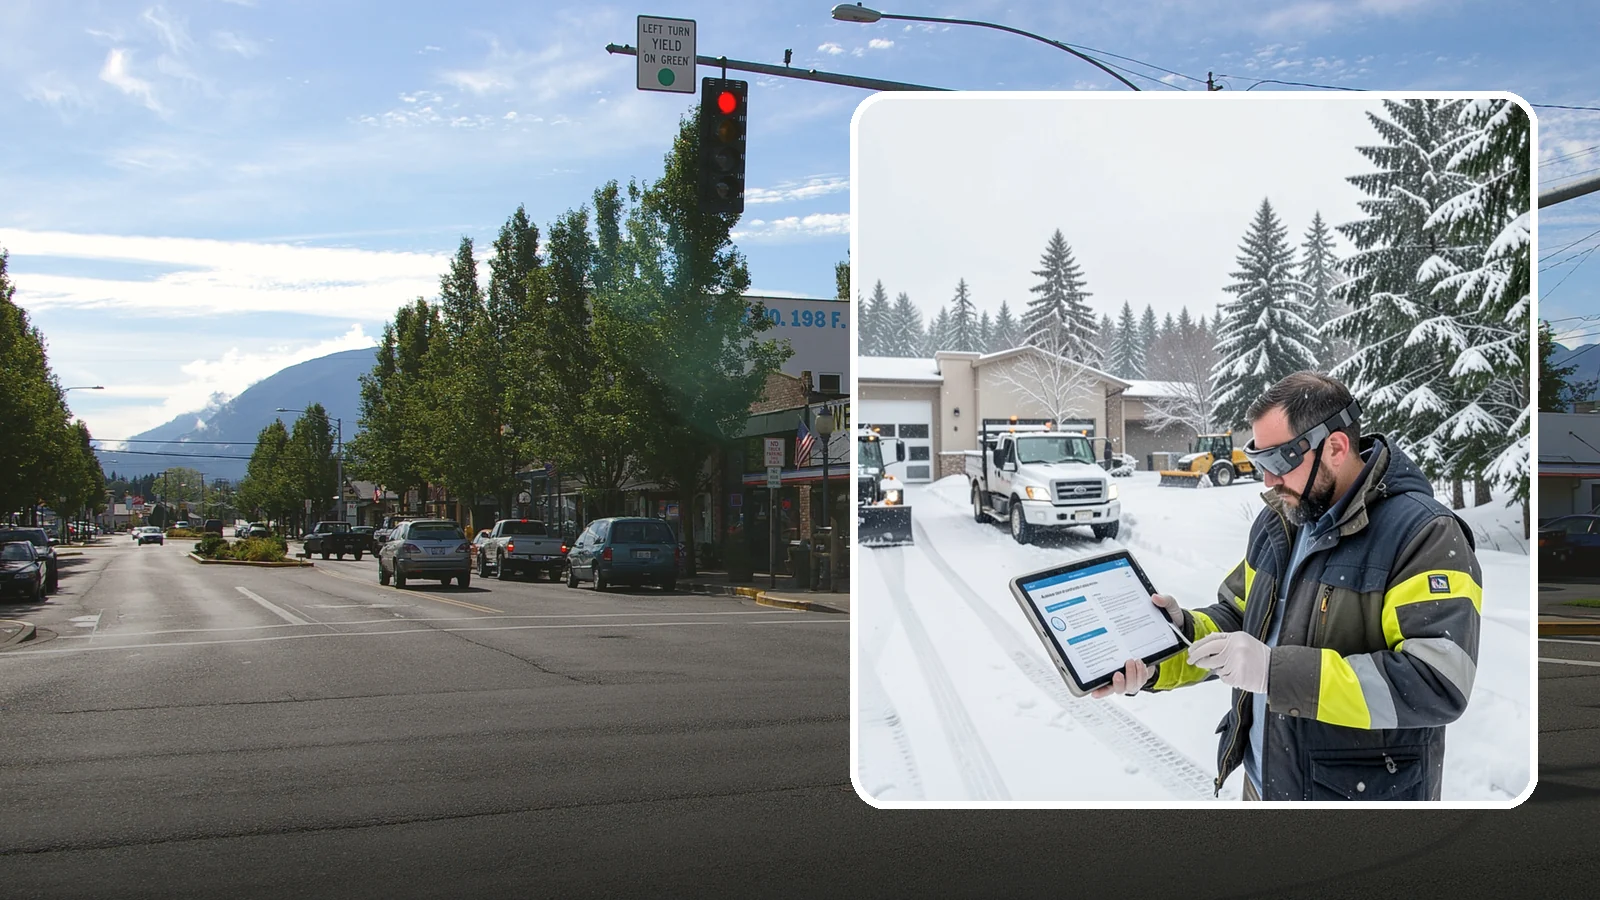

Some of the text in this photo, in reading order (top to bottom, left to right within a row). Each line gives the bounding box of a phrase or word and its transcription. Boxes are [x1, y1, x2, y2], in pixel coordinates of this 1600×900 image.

[643, 23, 690, 36] LEFT TURN
[652, 37, 682, 51] YIELD
[644, 53, 688, 66] ON GREEN
[791, 309, 826, 328] 198
[831, 311, 846, 329] F.
